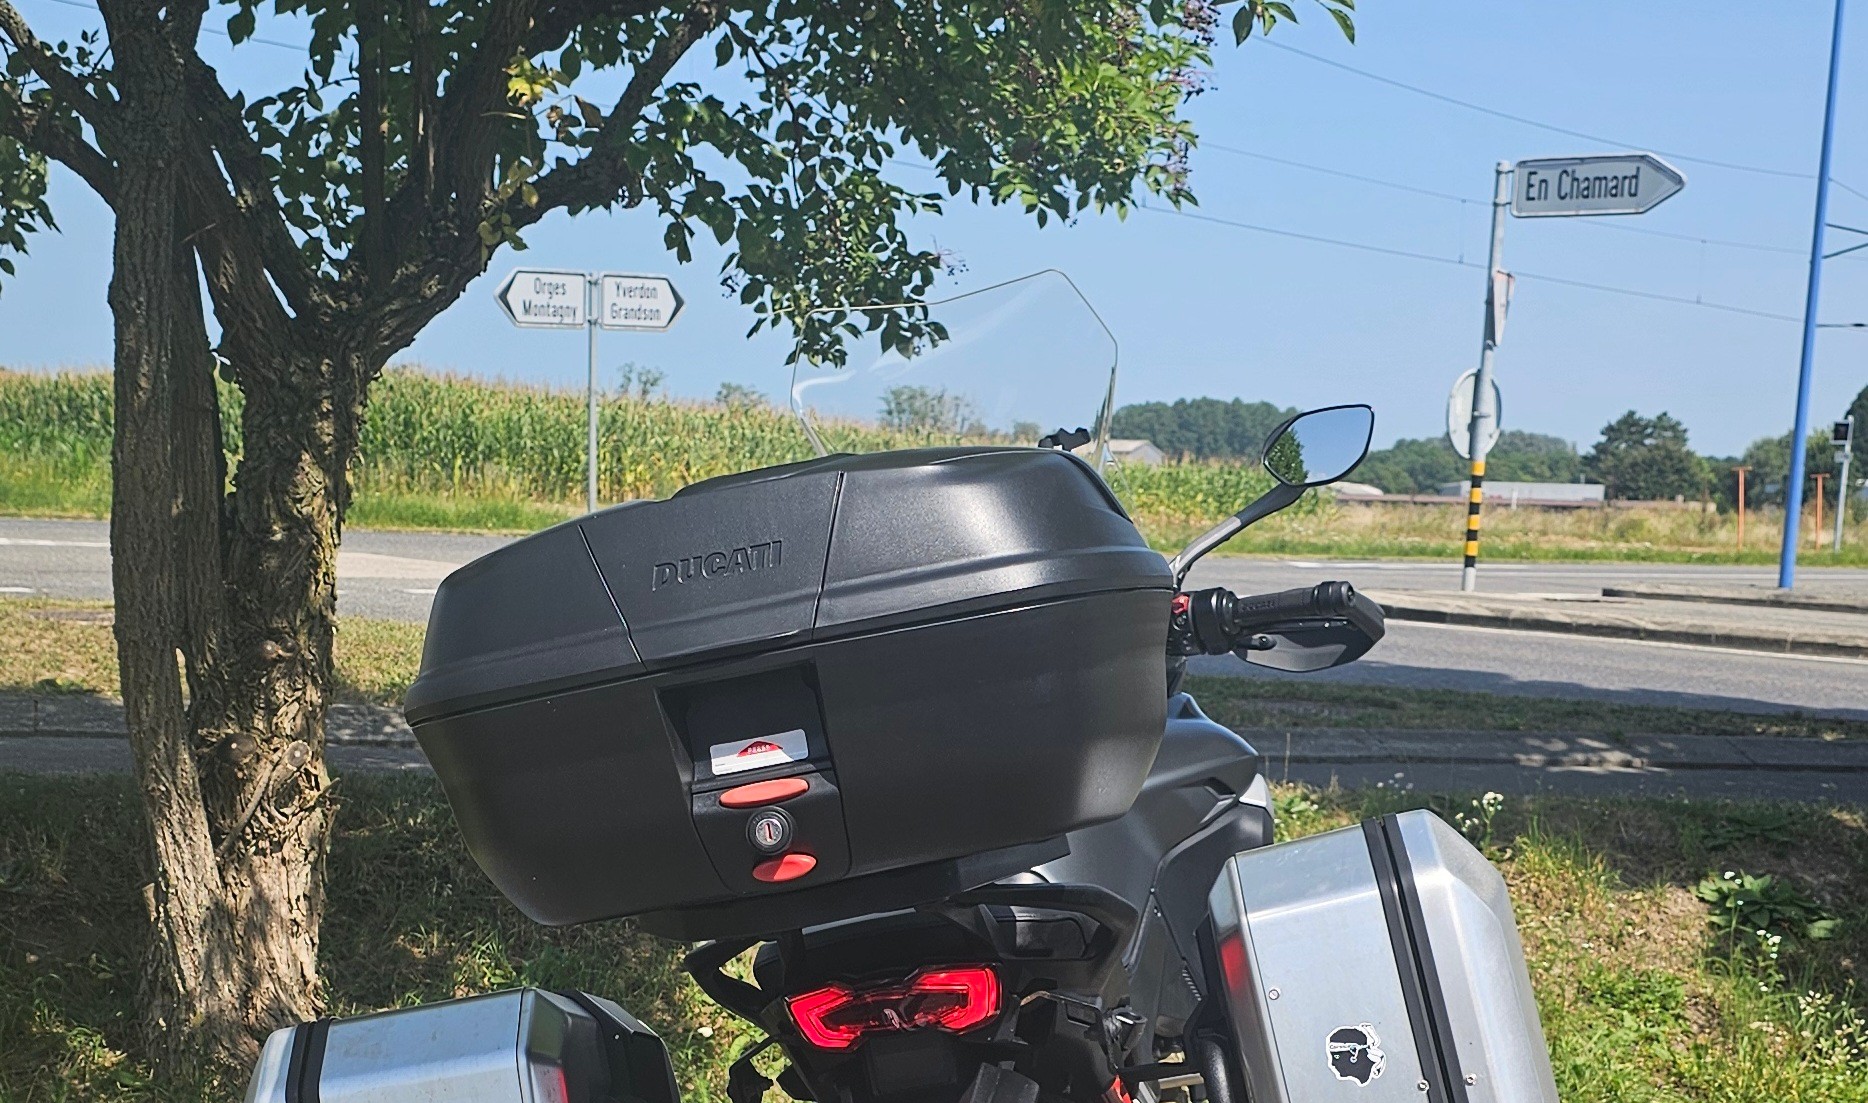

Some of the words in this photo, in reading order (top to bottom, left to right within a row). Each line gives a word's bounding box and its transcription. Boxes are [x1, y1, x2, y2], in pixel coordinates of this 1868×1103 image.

[1525, 171, 1548, 201] En
[1557, 166, 1641, 200] Chamard
[533, 277, 567, 300] Orges
[615, 281, 659, 299] Yverdon
[522, 299, 578, 323] Montagny
[611, 302, 661, 321] Grandson
[651, 539, 783, 592] DUCATI
